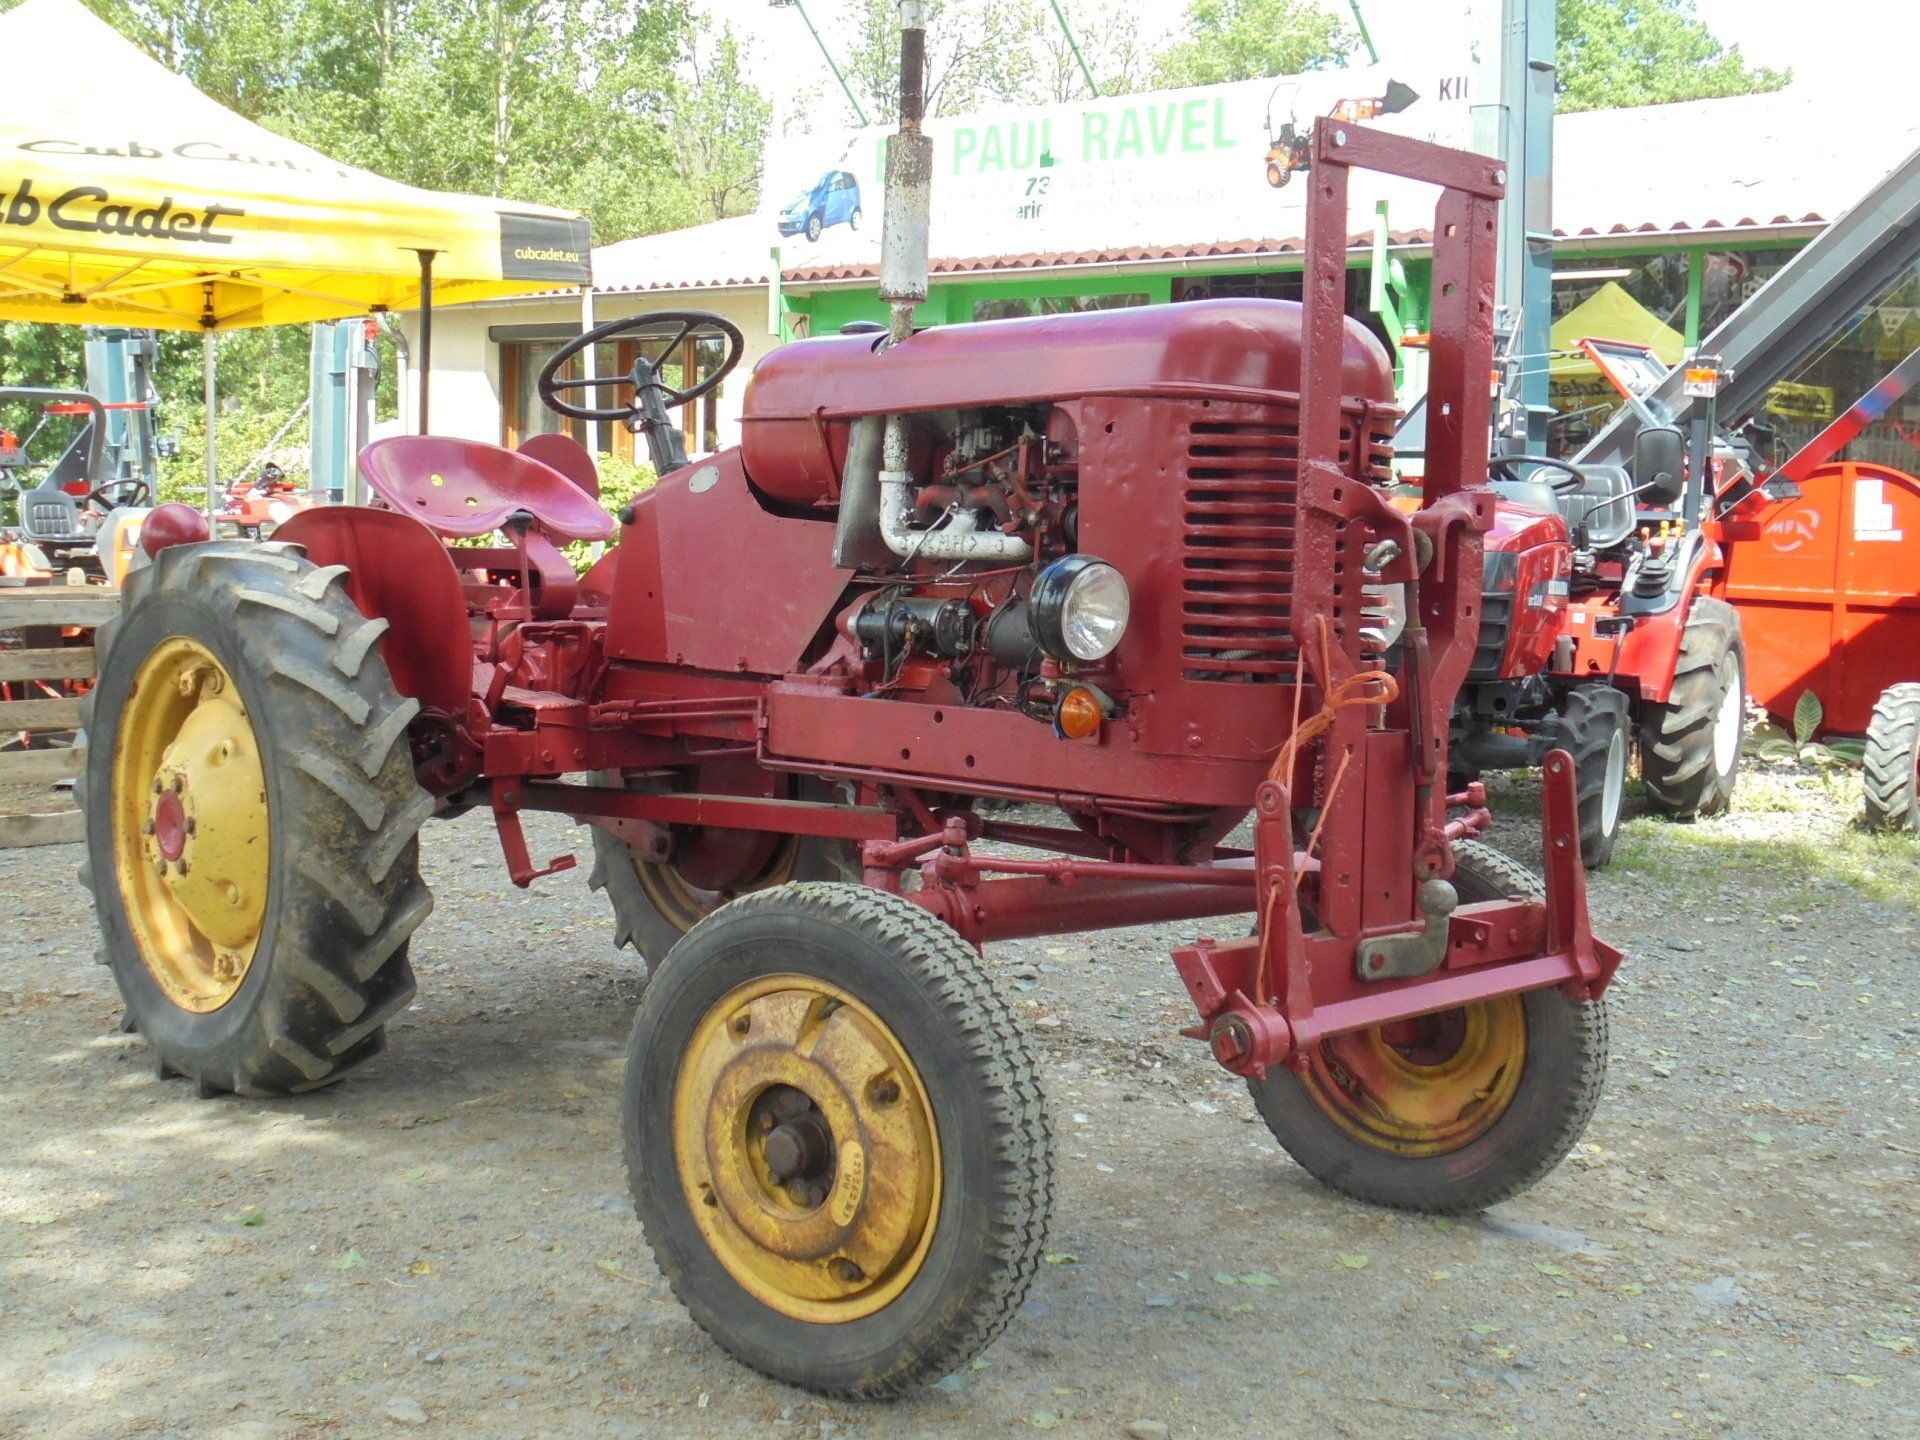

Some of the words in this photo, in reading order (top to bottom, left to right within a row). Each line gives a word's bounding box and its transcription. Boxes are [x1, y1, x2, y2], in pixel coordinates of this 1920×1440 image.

[952, 118, 1061, 175] PAUL
[1082, 96, 1239, 163] RAVEL
[48, 186, 245, 245] Cadet
[514, 246, 579, 263] cubcadet.eu
